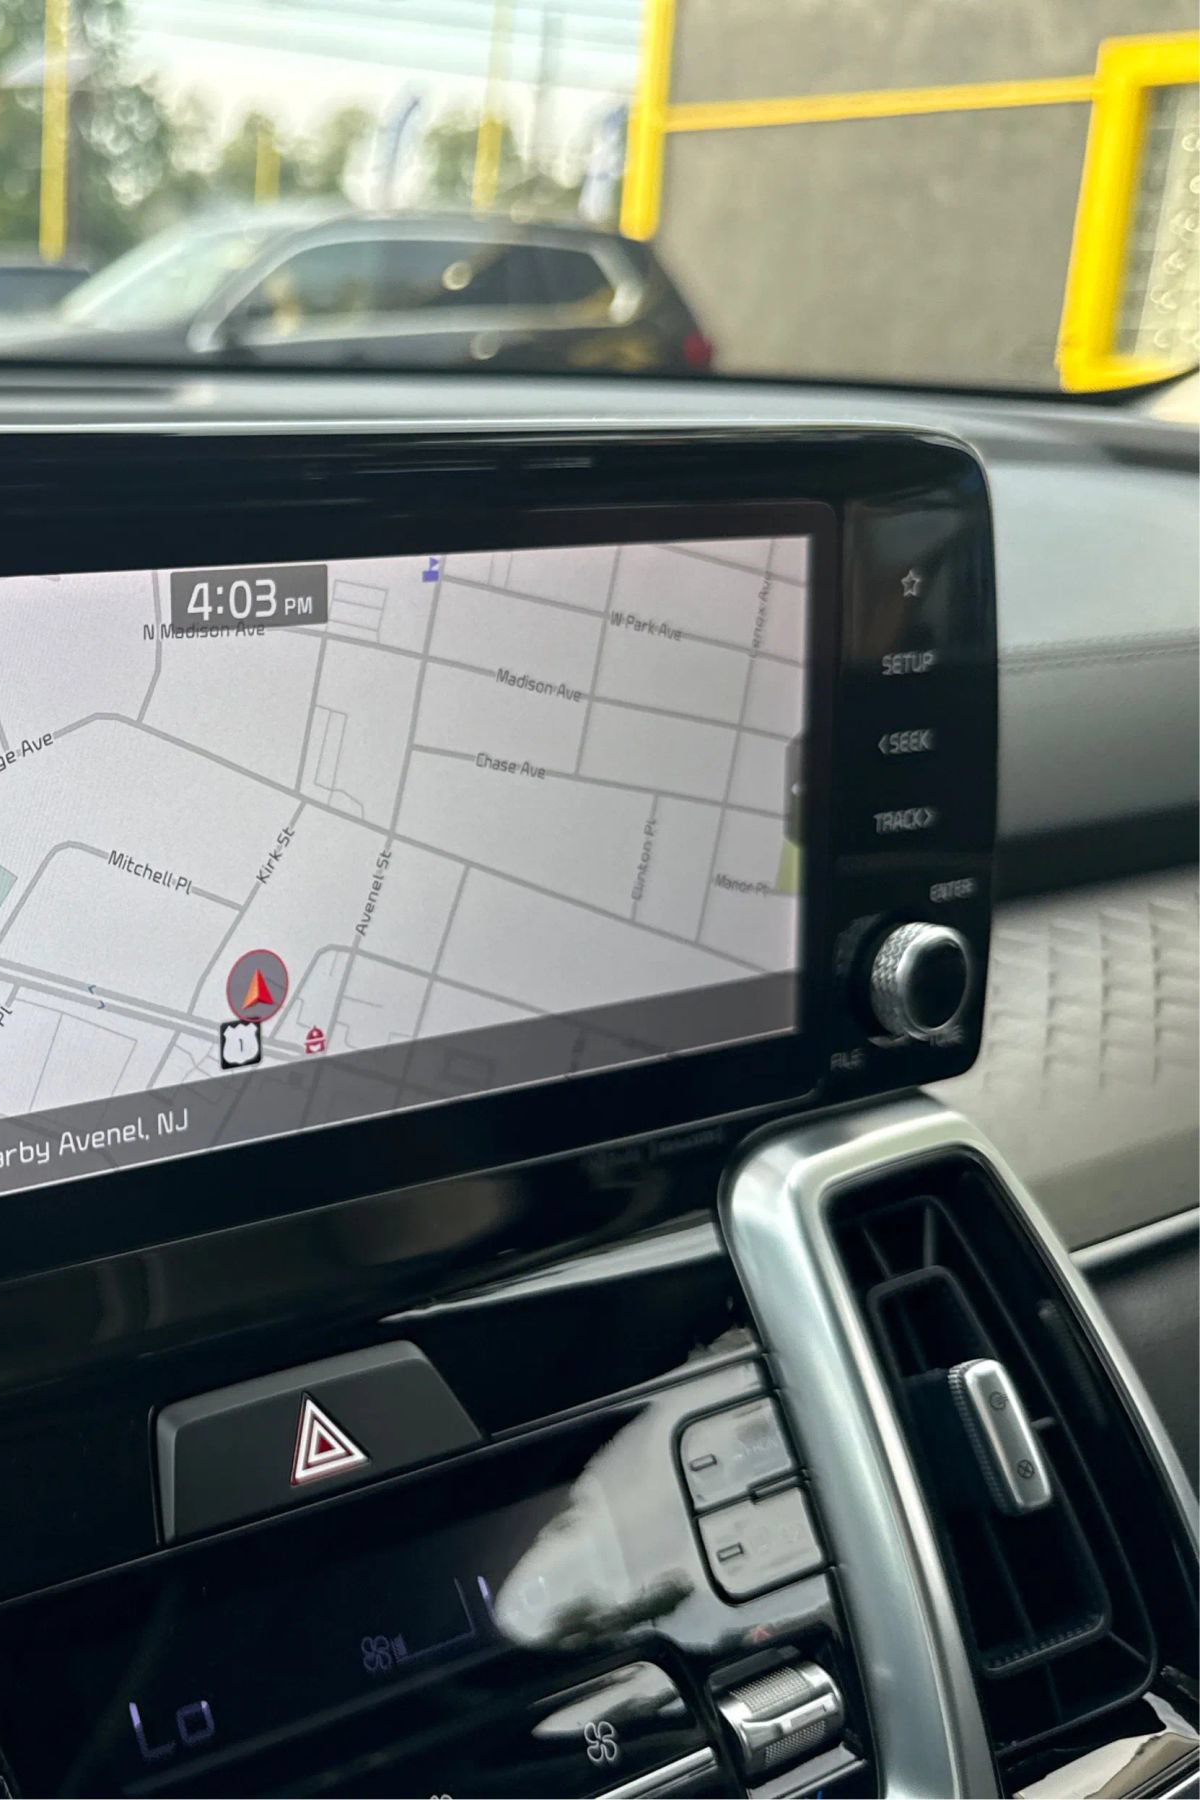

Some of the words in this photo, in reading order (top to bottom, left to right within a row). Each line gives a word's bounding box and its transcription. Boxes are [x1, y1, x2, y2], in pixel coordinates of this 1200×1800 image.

[187, 579, 277, 621] 4:03
[284, 596, 313, 615] PM
[143, 624, 155, 640] N
[160, 621, 231, 640] Madison
[235, 620, 266, 638] Ave
[611, 611, 623, 627] W
[625, 614, 655, 635] Park
[656, 621, 682, 641] Ave
[882, 652, 935, 675] SETUP
[496, 667, 554, 696] Madison
[554, 683, 583, 702] Ave
[19, 731, 54, 759] Ave
[889, 729, 931, 754] SEEK
[475, 752, 517, 774] Chase
[518, 760, 546, 780] Ave
[256, 848, 279, 885] Kirk
[277, 825, 295, 851] St
[108, 850, 176, 888] Mitchell
[175, 877, 193, 895] Pl
[356, 870, 386, 936] Avenel
[376, 849, 392, 872] St
[59, 1119, 150, 1156] Avenel,
[158, 1108, 188, 1134] NJ
